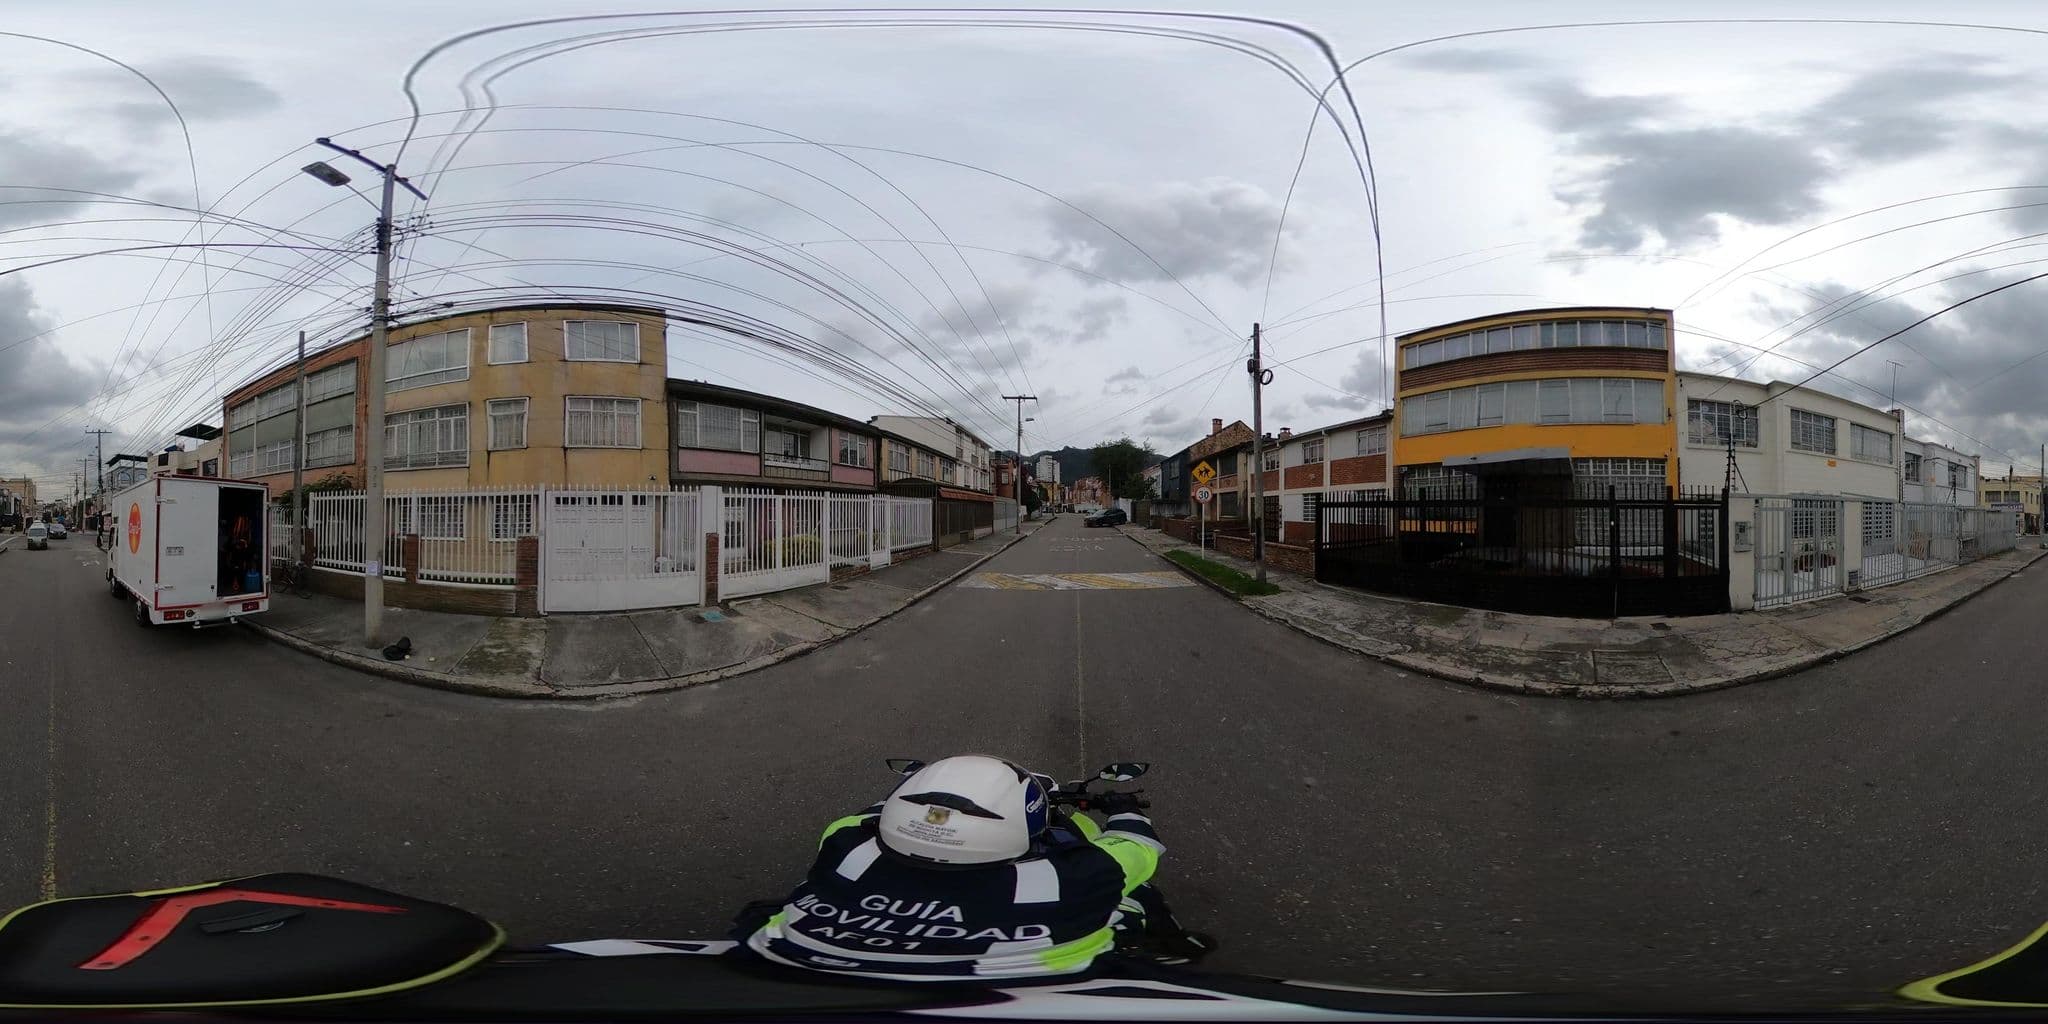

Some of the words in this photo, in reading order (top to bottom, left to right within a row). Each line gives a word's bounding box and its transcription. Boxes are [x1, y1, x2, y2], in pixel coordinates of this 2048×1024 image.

[1198, 490, 1209, 499] 30
[796, 893, 1051, 941] MOVILIDAD
[859, 894, 964, 923] GUÍA
